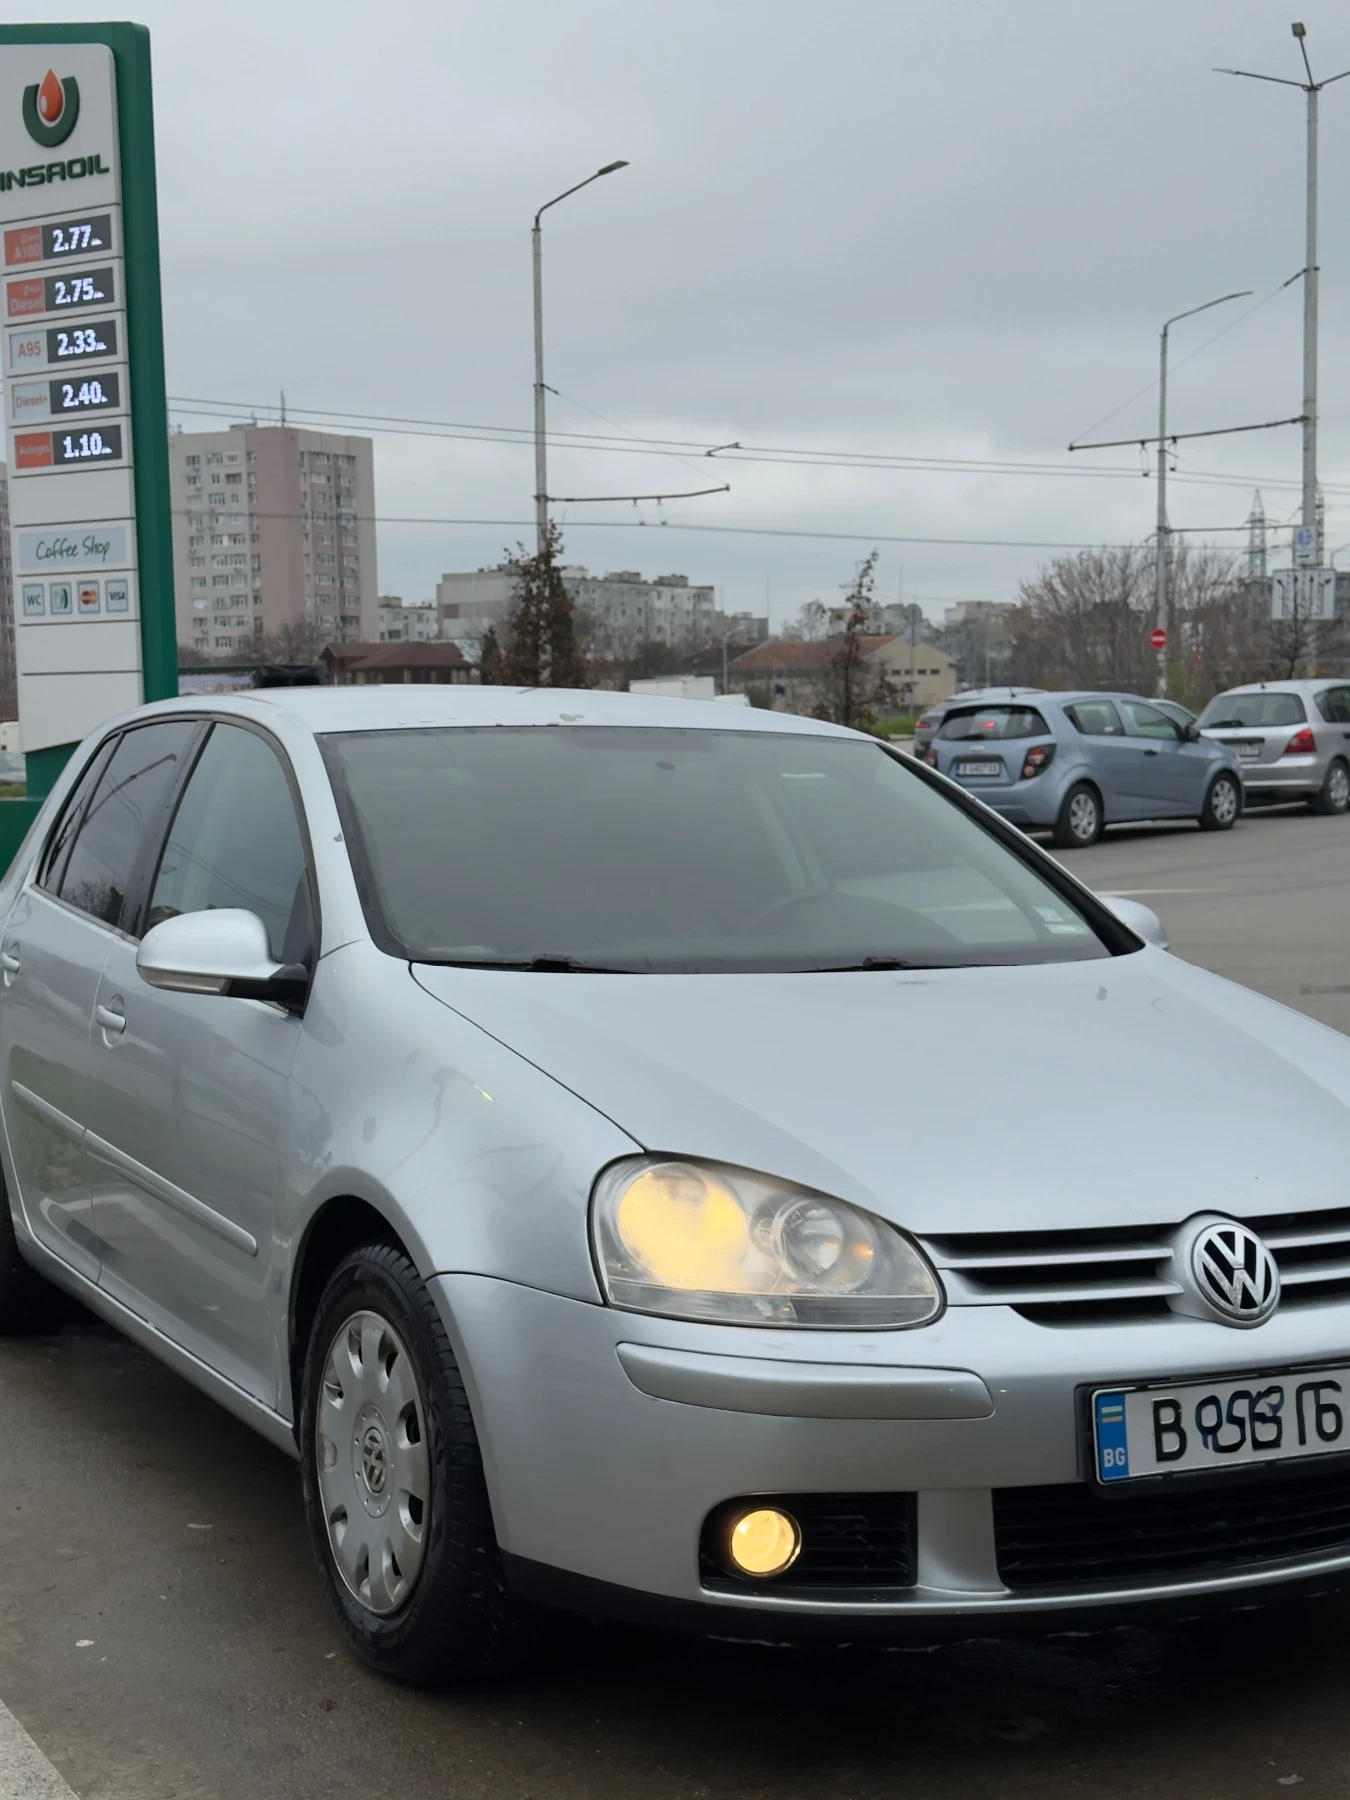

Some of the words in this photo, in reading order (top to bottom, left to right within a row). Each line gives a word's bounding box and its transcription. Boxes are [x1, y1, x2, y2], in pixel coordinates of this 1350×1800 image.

[0, 154, 109, 191] INSAOIL
[18, 340, 41, 358] A95
[36, 538, 78, 560] Coffee
[83, 535, 110, 562] Shop
[27, 595, 41, 606] WC
[109, 591, 125, 601] VISA
[1103, 1447, 1126, 1468] BG
